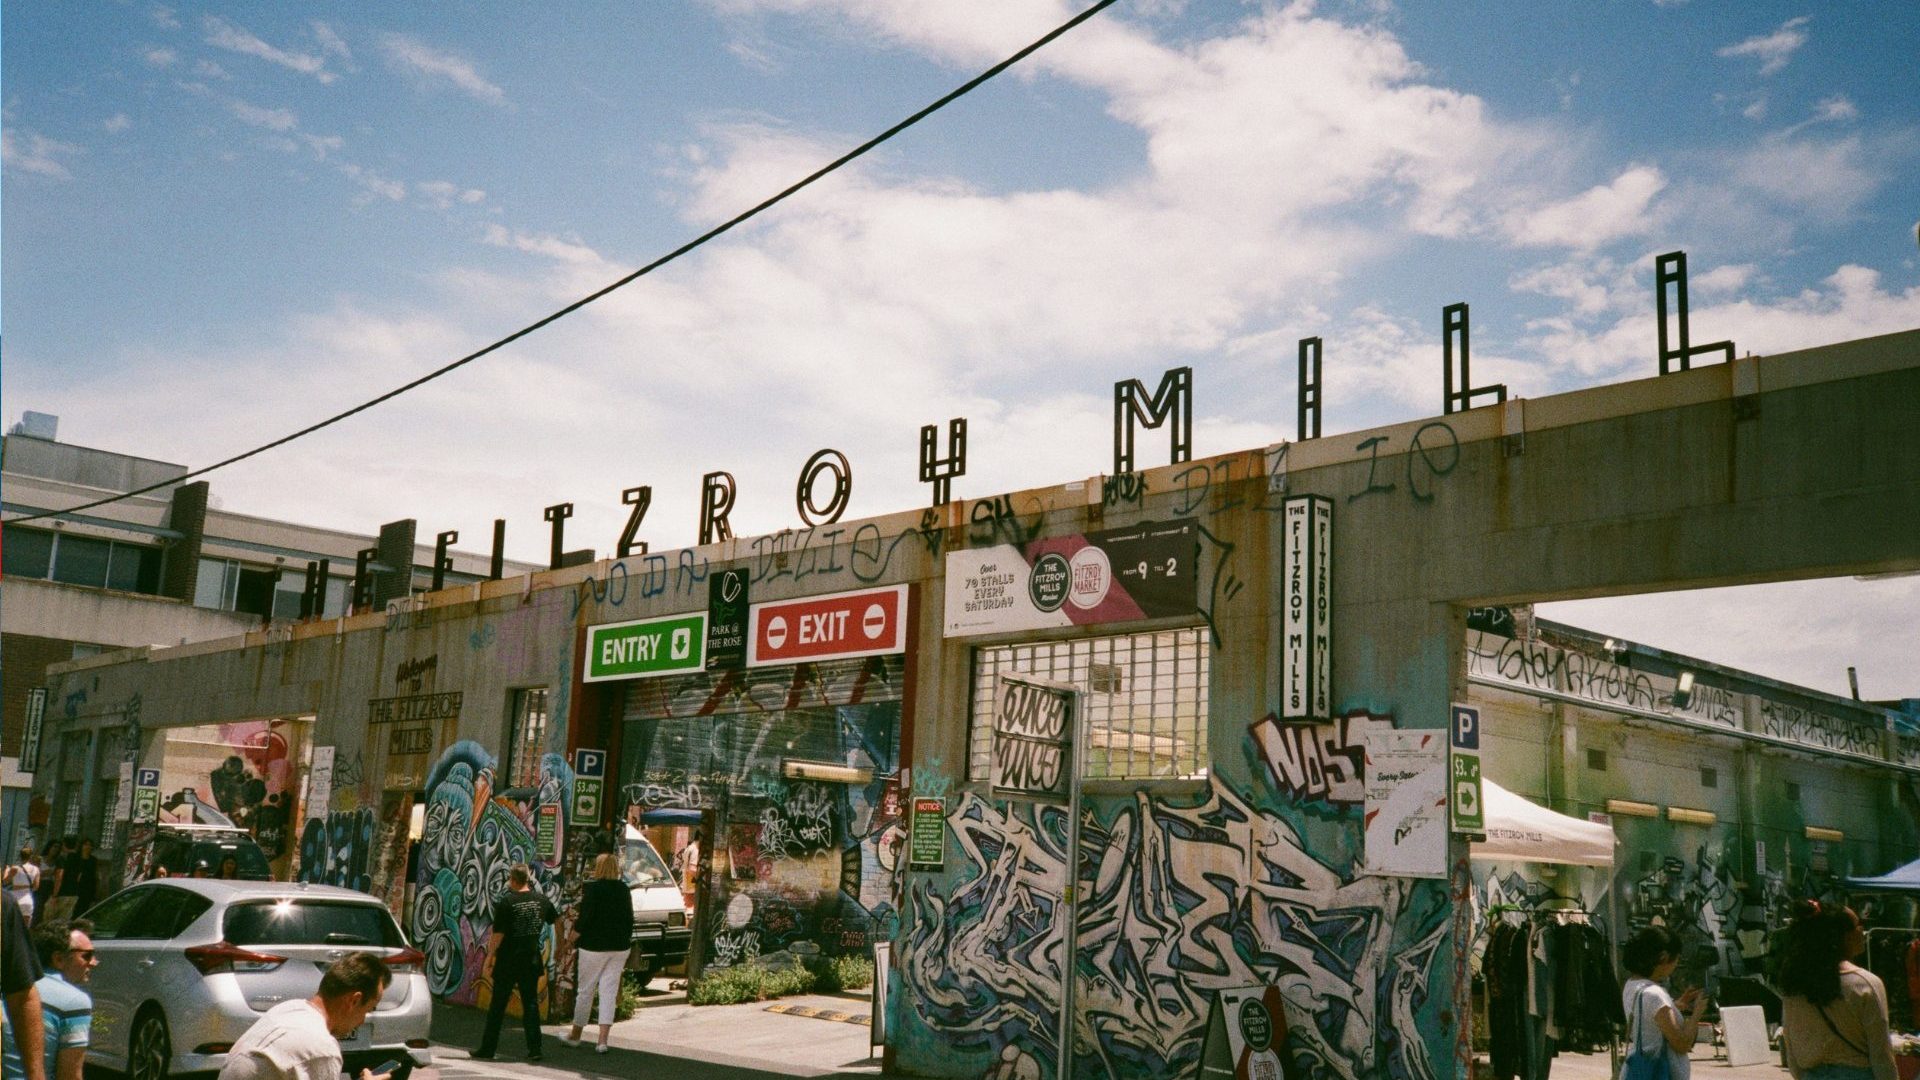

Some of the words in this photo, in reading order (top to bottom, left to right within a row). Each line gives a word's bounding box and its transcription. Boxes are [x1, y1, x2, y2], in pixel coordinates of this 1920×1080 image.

[1288, 506, 1305, 516] THE
[1316, 506, 1329, 518] THE
[1044, 563, 1057, 572] THE
[1138, 561, 1148, 580] 9
[1166, 557, 1177, 576] 2
[1291, 521, 1302, 623] FITZROY
[1318, 522, 1327, 627] FITZROY
[981, 574, 1015, 587] STALLS
[1035, 572, 1066, 583] FITZROY
[975, 587, 1005, 600] EVERY
[1040, 583, 1060, 592] MILLS
[965, 597, 1014, 612] SATURDAY
[711, 625, 730, 636] PARK
[731, 622, 739, 635] @
[799, 610, 850, 644] EXIT
[602, 634, 661, 665] ENTRY
[708, 639, 721, 649] THE
[723, 636, 742, 647] ROSE
[1290, 634, 1302, 709] MILLS
[1317, 635, 1327, 710] MILLS
[1459, 713, 1472, 743] P
[584, 755, 597, 773] P
[144, 772, 155, 784] P
[1488, 829, 1500, 839] THE
[1501, 830, 1525, 840] FITZROY
[1526, 833, 1542, 841] MILLS
